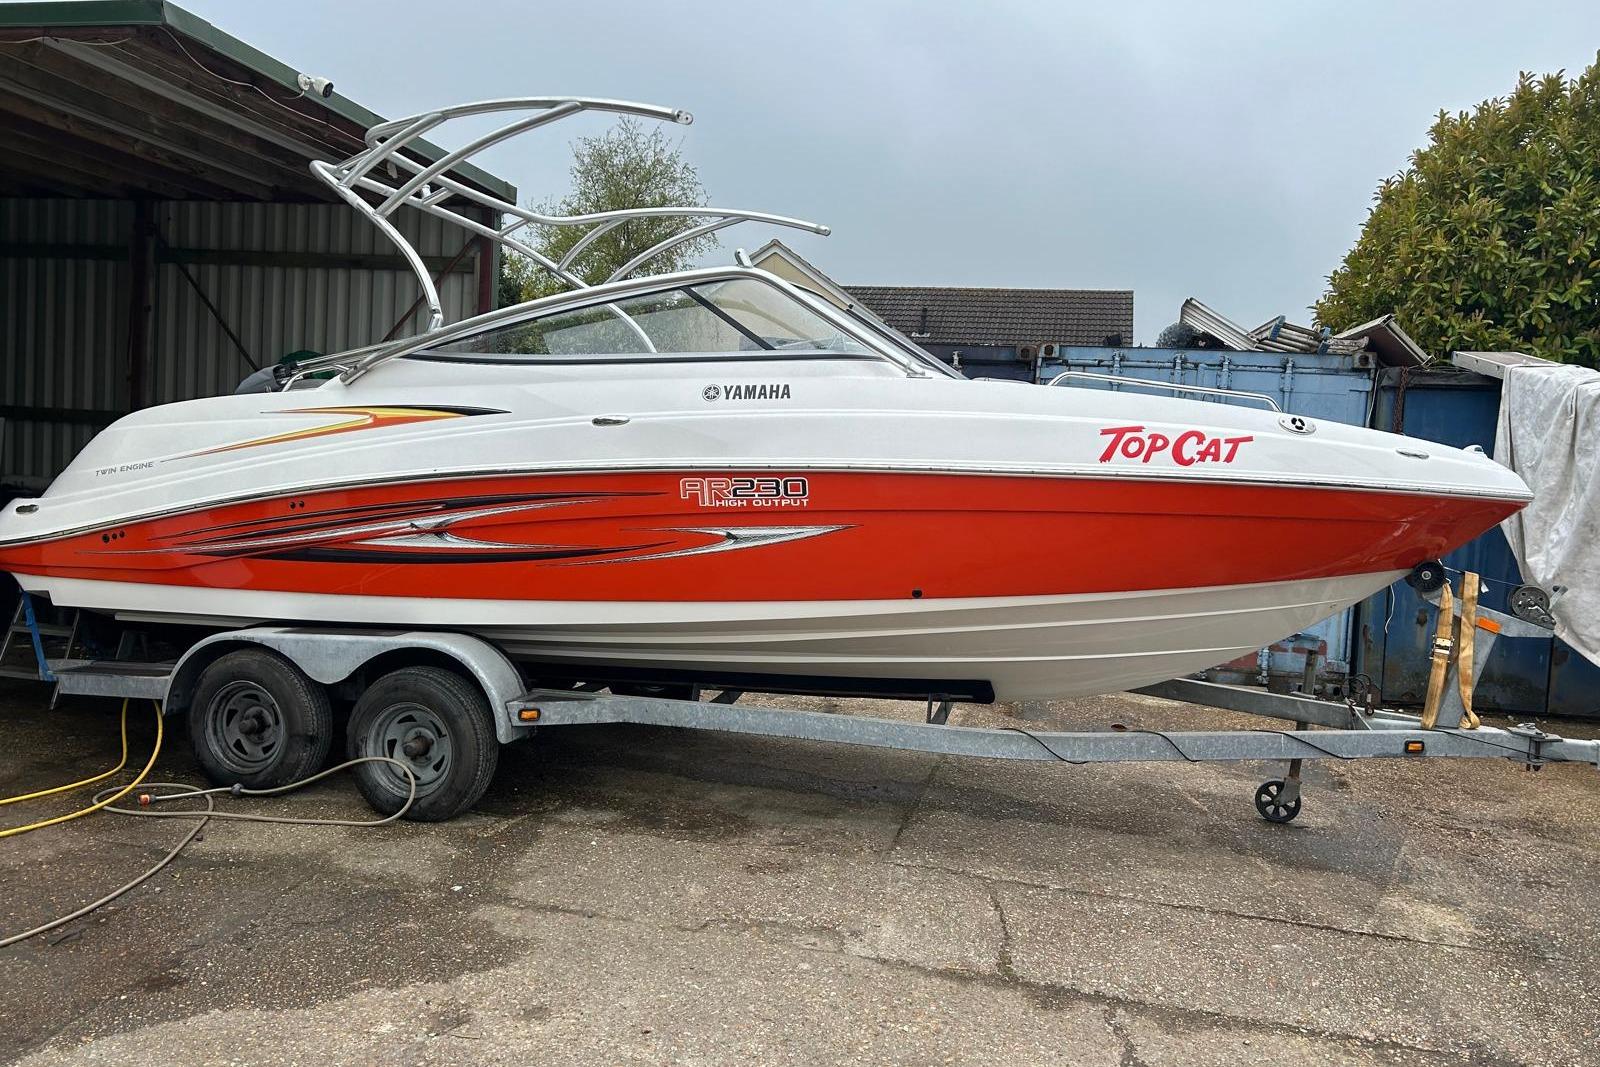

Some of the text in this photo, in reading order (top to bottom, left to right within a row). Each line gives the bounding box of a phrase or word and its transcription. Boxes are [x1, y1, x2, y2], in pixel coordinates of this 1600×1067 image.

[723, 383, 791, 400] YAMAHA
[1099, 425, 1254, 466] TOP CAT
[95, 461, 154, 477] TWIN ENGINE
[680, 476, 809, 507] AR230
[716, 499, 809, 507] HIGH OUTPUT
